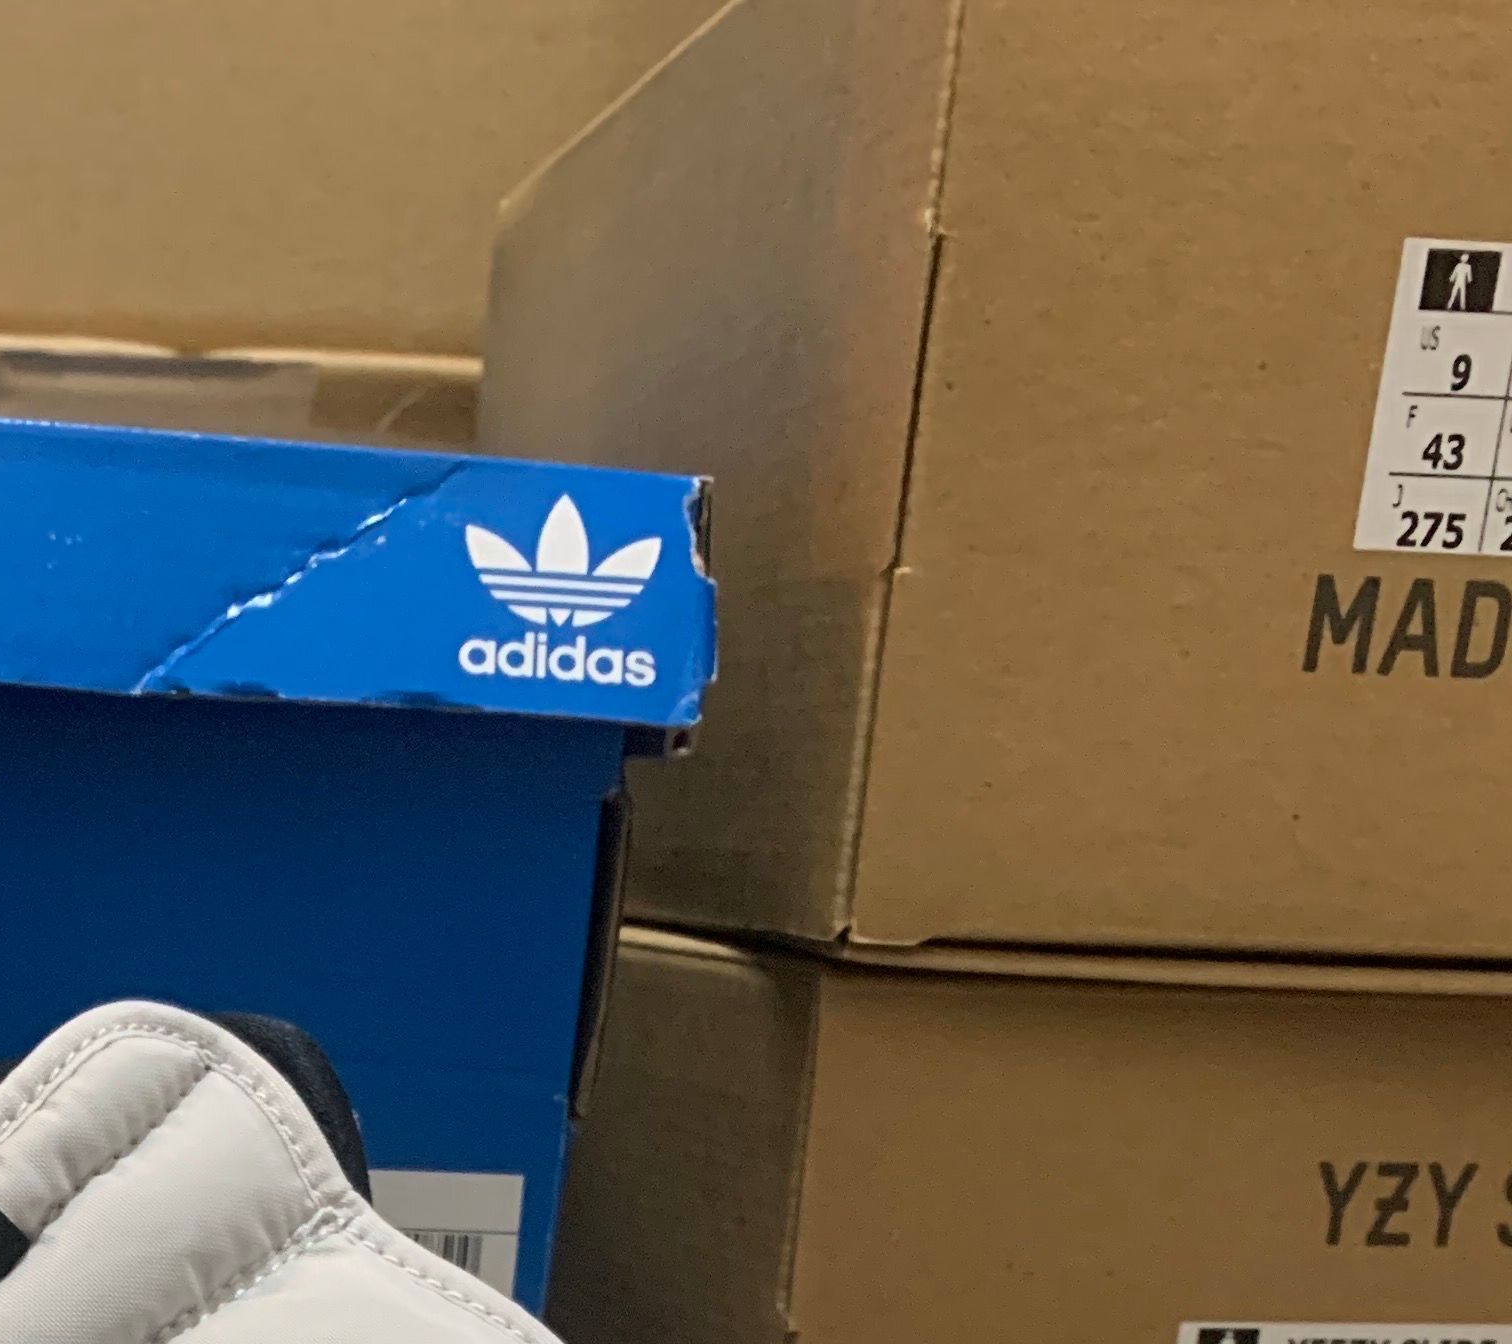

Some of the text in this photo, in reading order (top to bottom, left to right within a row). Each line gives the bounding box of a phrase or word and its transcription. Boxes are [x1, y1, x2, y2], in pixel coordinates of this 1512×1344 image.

[1420, 325, 1440, 350] US
[1450, 354, 1472, 391] 9
[1406, 405, 1418, 428] F
[1422, 433, 1466, 471] 43
[1396, 511, 1467, 549] 275
[458, 632, 657, 687] adidas
